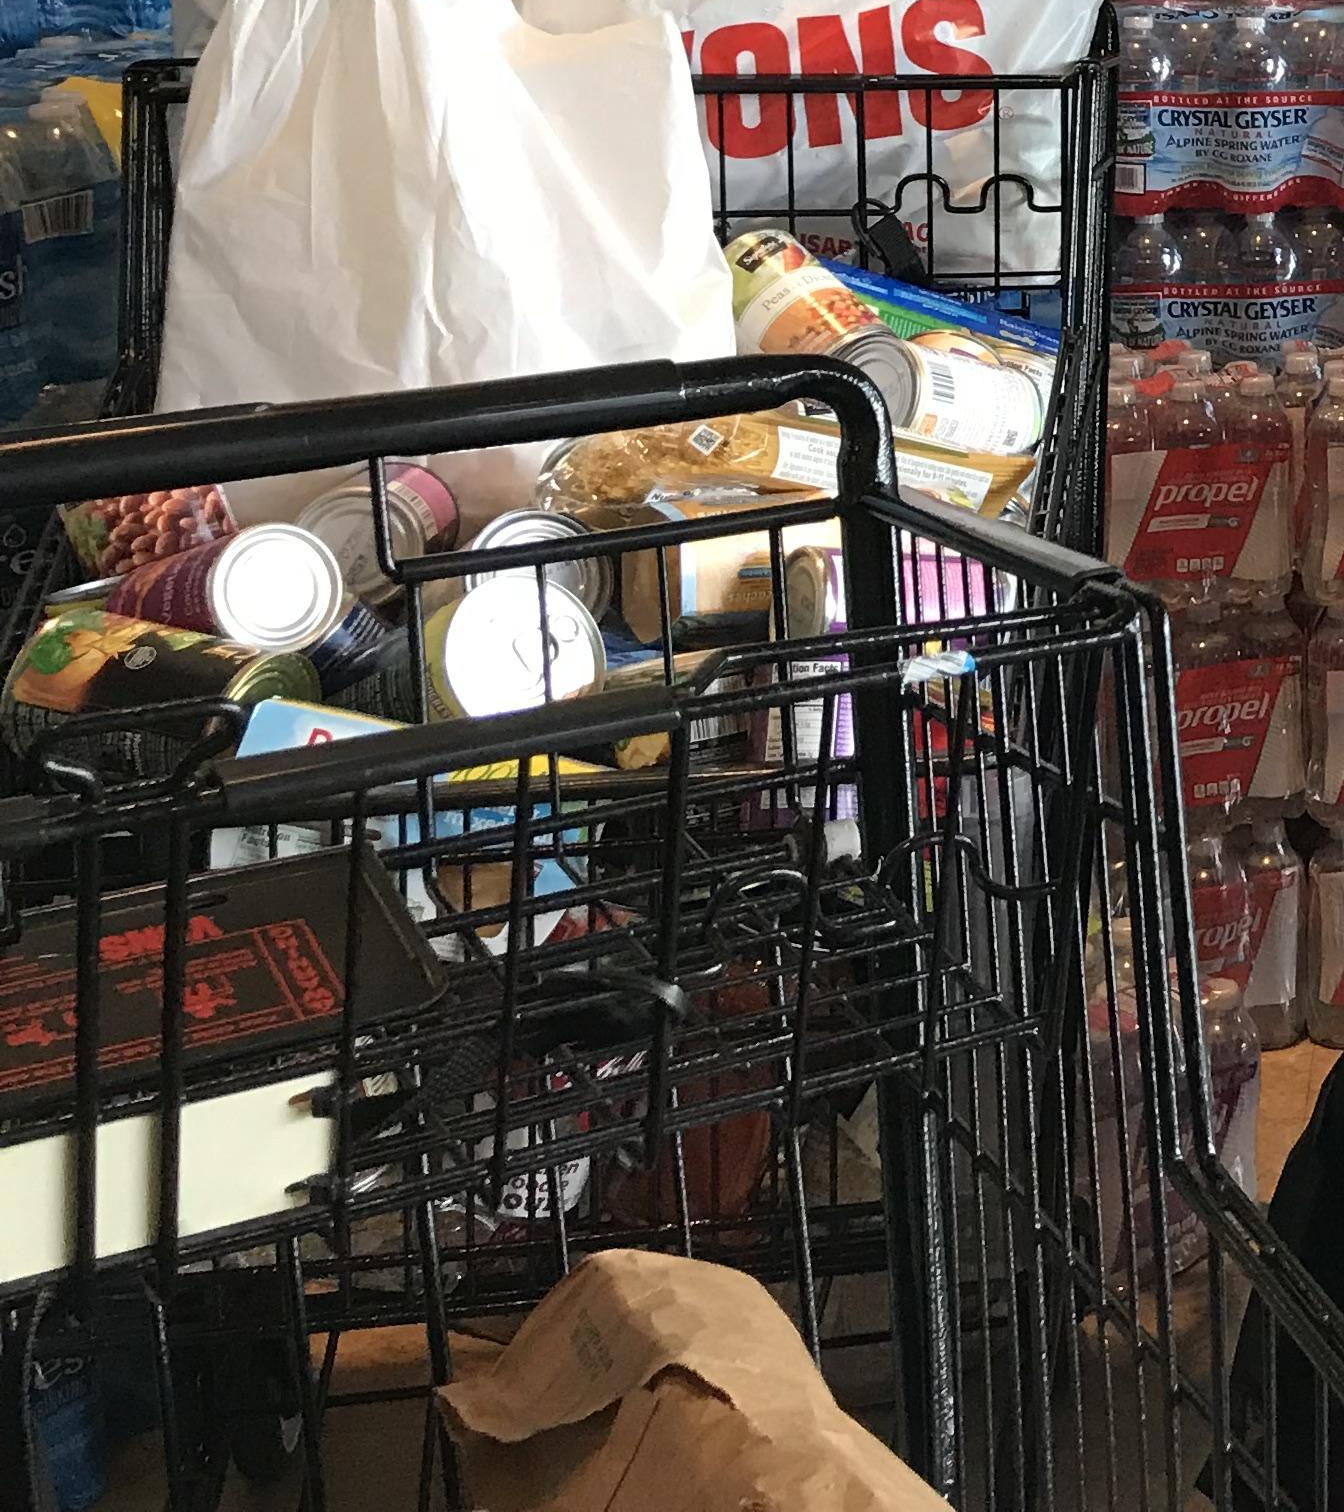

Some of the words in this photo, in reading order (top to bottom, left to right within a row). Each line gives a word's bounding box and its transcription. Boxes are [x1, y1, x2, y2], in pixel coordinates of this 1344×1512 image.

[1153, 94, 1210, 104] BOTTLED
[1234, 94, 1258, 104] THE
[1265, 94, 1314, 104] SOURCE
[1157, 108, 1232, 128] CRYSTAL
[1235, 107, 1307, 128] GEYSER
[1194, 128, 1273, 138] NATURAL
[1166, 135, 1211, 149] ALPINE
[1213, 137, 1258, 152] SPRING
[1260, 135, 1300, 151] WATER
[1195, 150, 1210, 159] BY
[1229, 152, 1273, 163] ROXANE
[761, 284, 791, 312] Peas
[1167, 299, 1240, 319] CRYSTAL
[1244, 297, 1317, 319] GEYSER
[1154, 476, 1260, 511] propel
